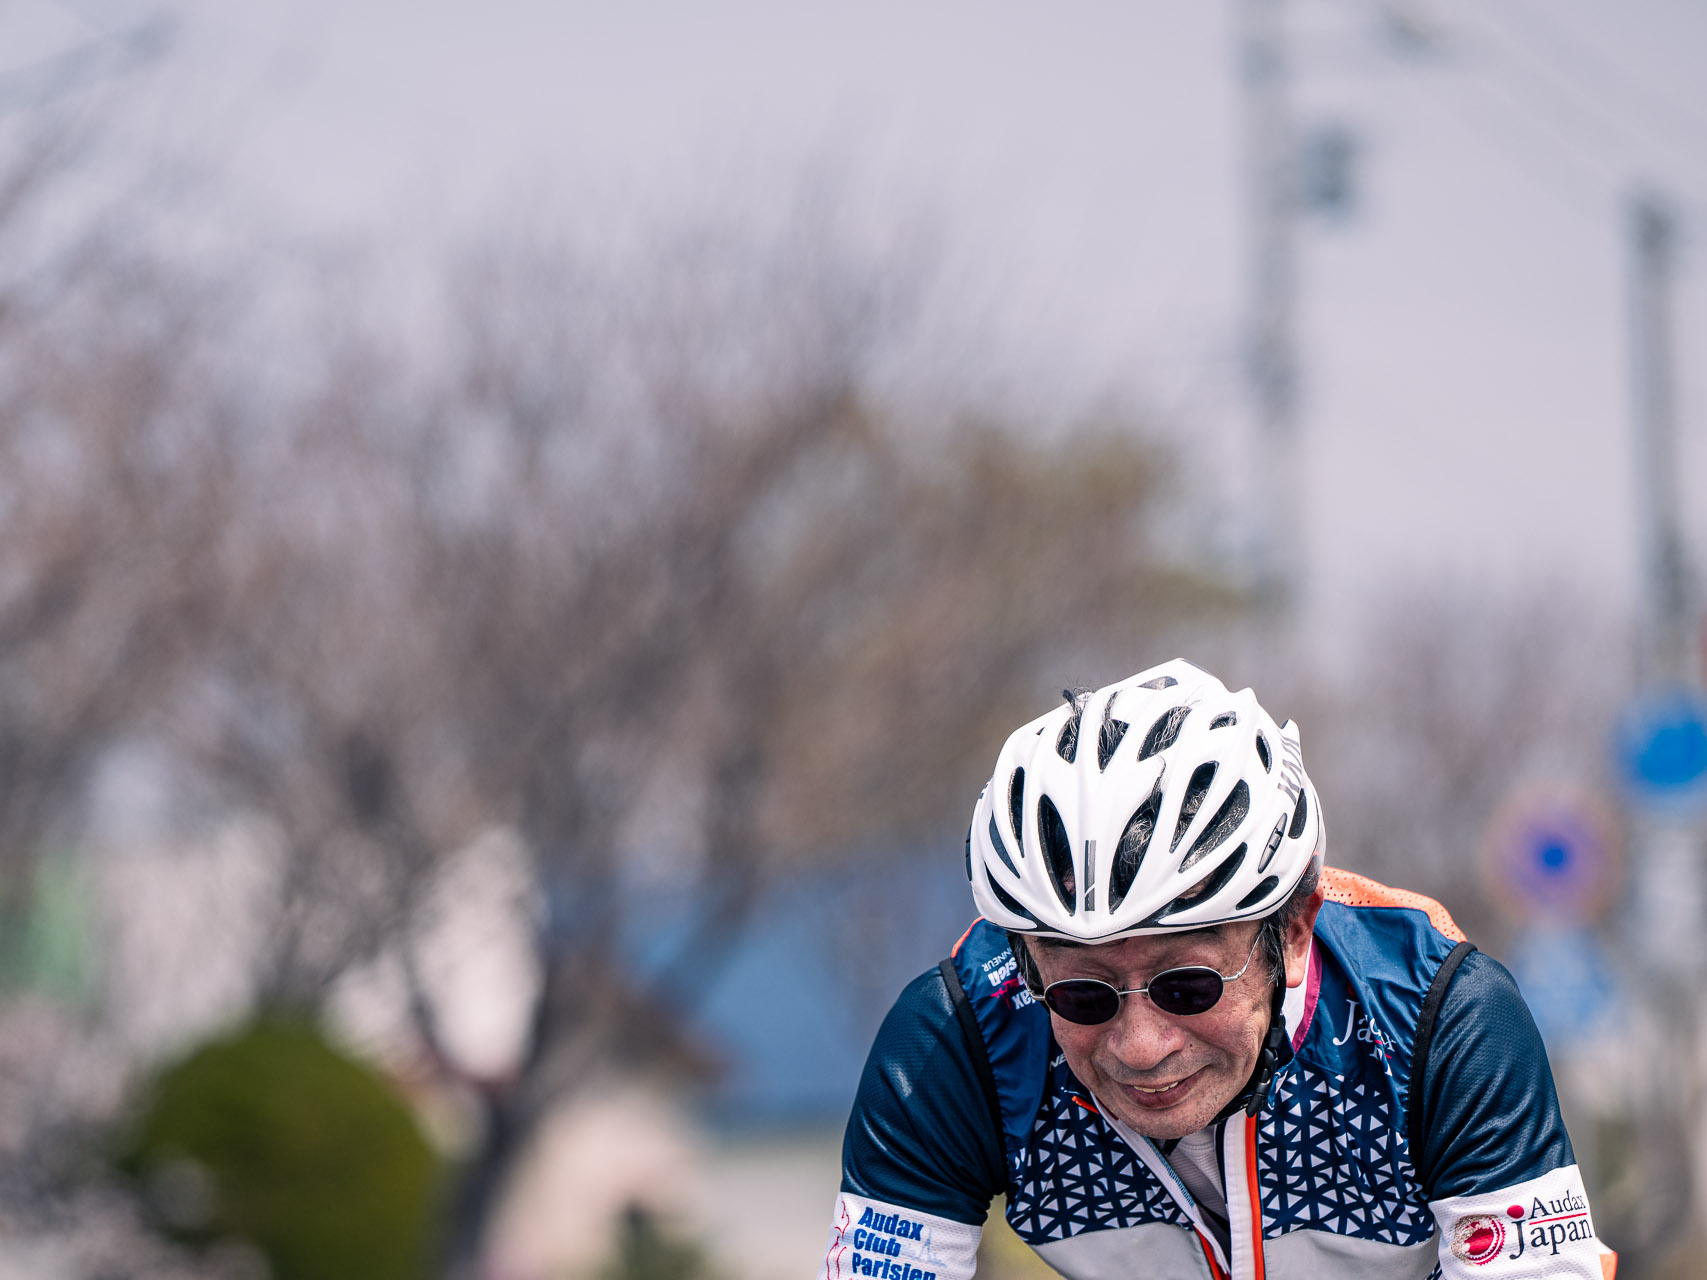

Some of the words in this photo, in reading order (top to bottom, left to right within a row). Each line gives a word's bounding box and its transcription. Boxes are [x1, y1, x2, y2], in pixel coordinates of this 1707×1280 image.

[1528, 1189, 1587, 1219] Audax
[857, 1206, 924, 1241] Audax
[1509, 1218, 1593, 1260] Japan
[853, 1228, 902, 1258] Club
